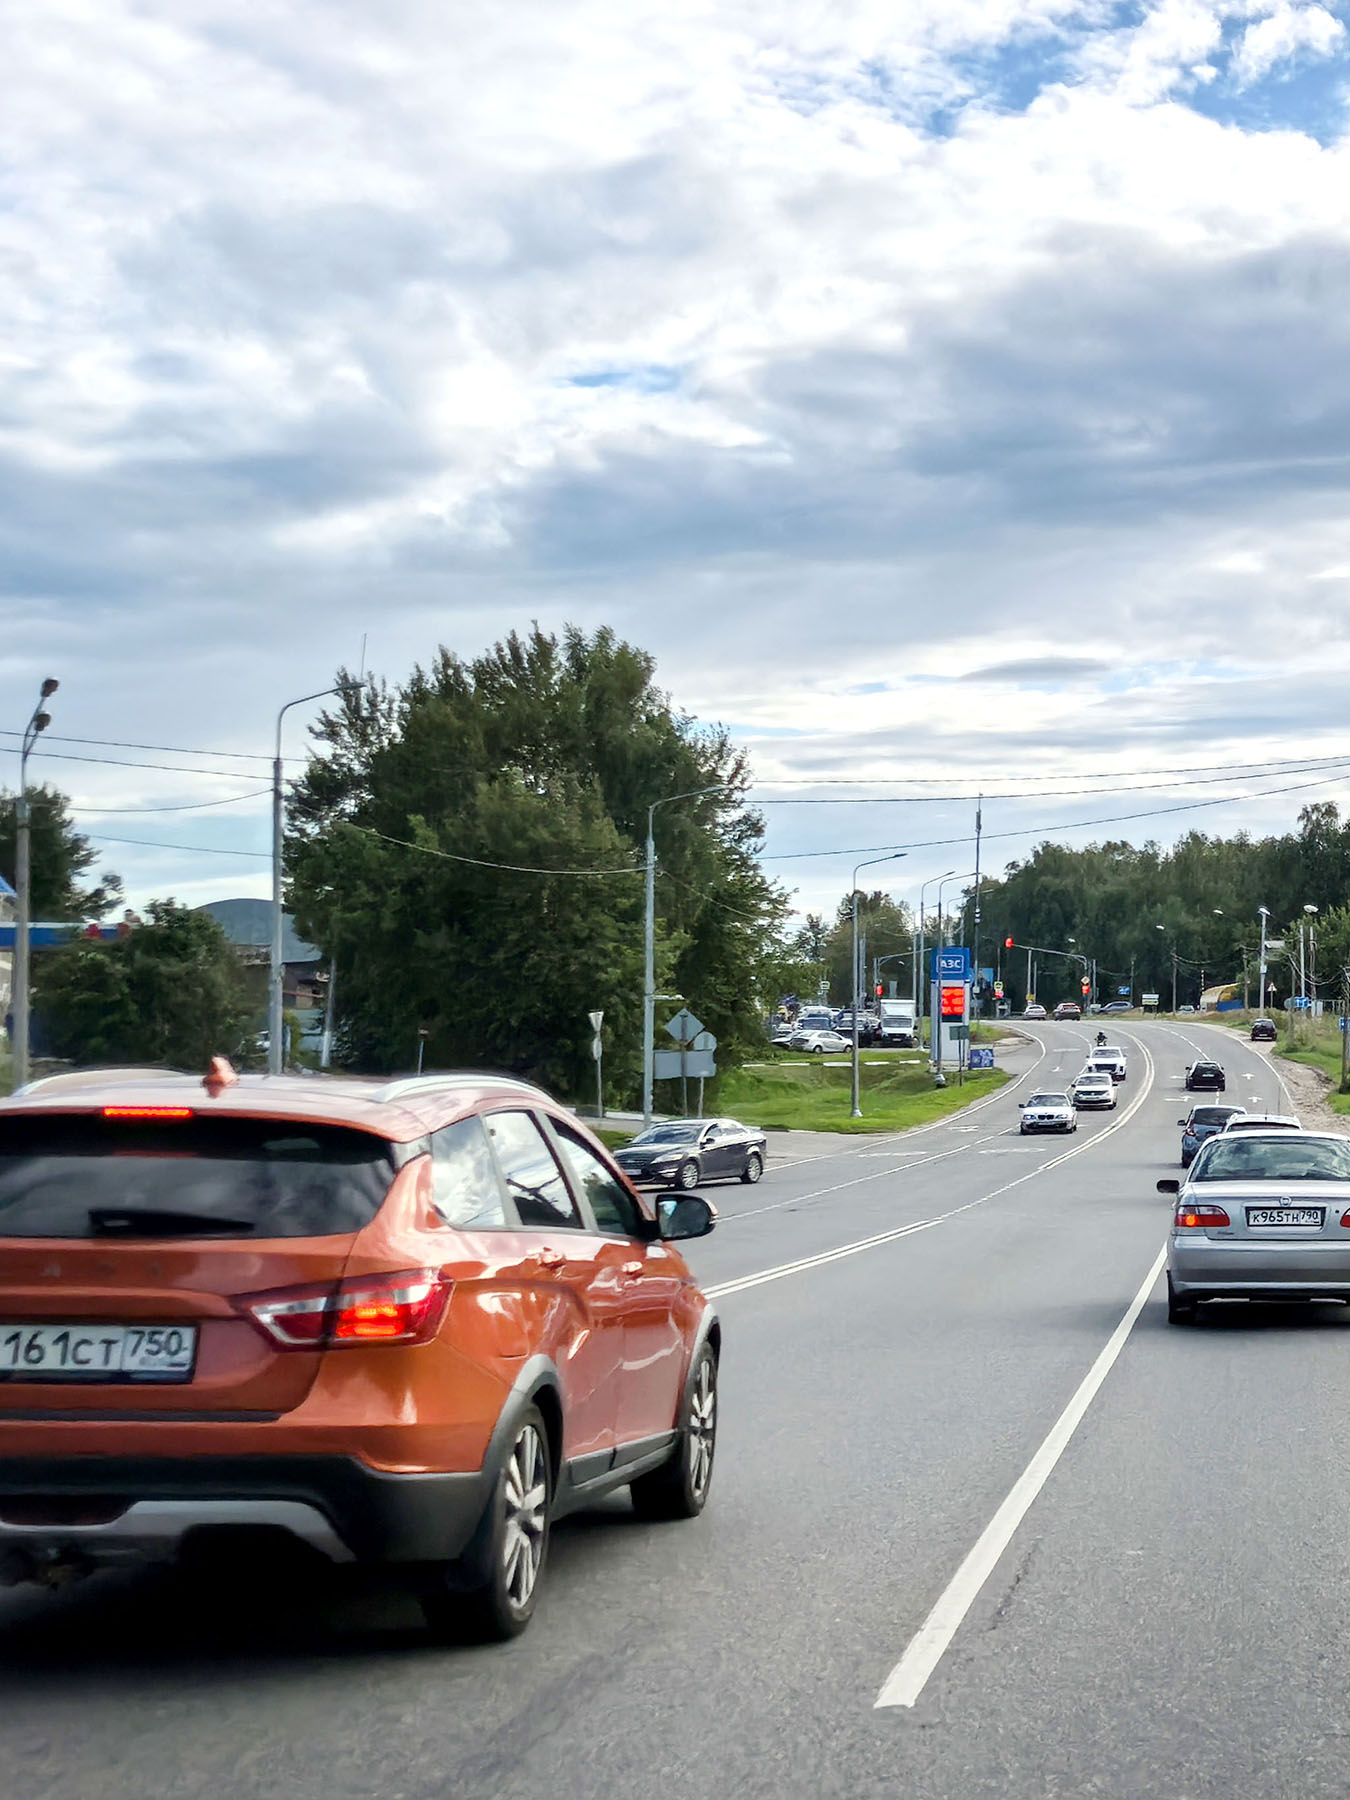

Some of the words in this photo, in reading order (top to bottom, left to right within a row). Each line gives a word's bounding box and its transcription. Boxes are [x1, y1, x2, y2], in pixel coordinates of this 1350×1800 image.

[940, 959, 961, 969] АЗС
[1301, 1210, 1319, 1220] 790
[128, 1329, 183, 1357] 750
